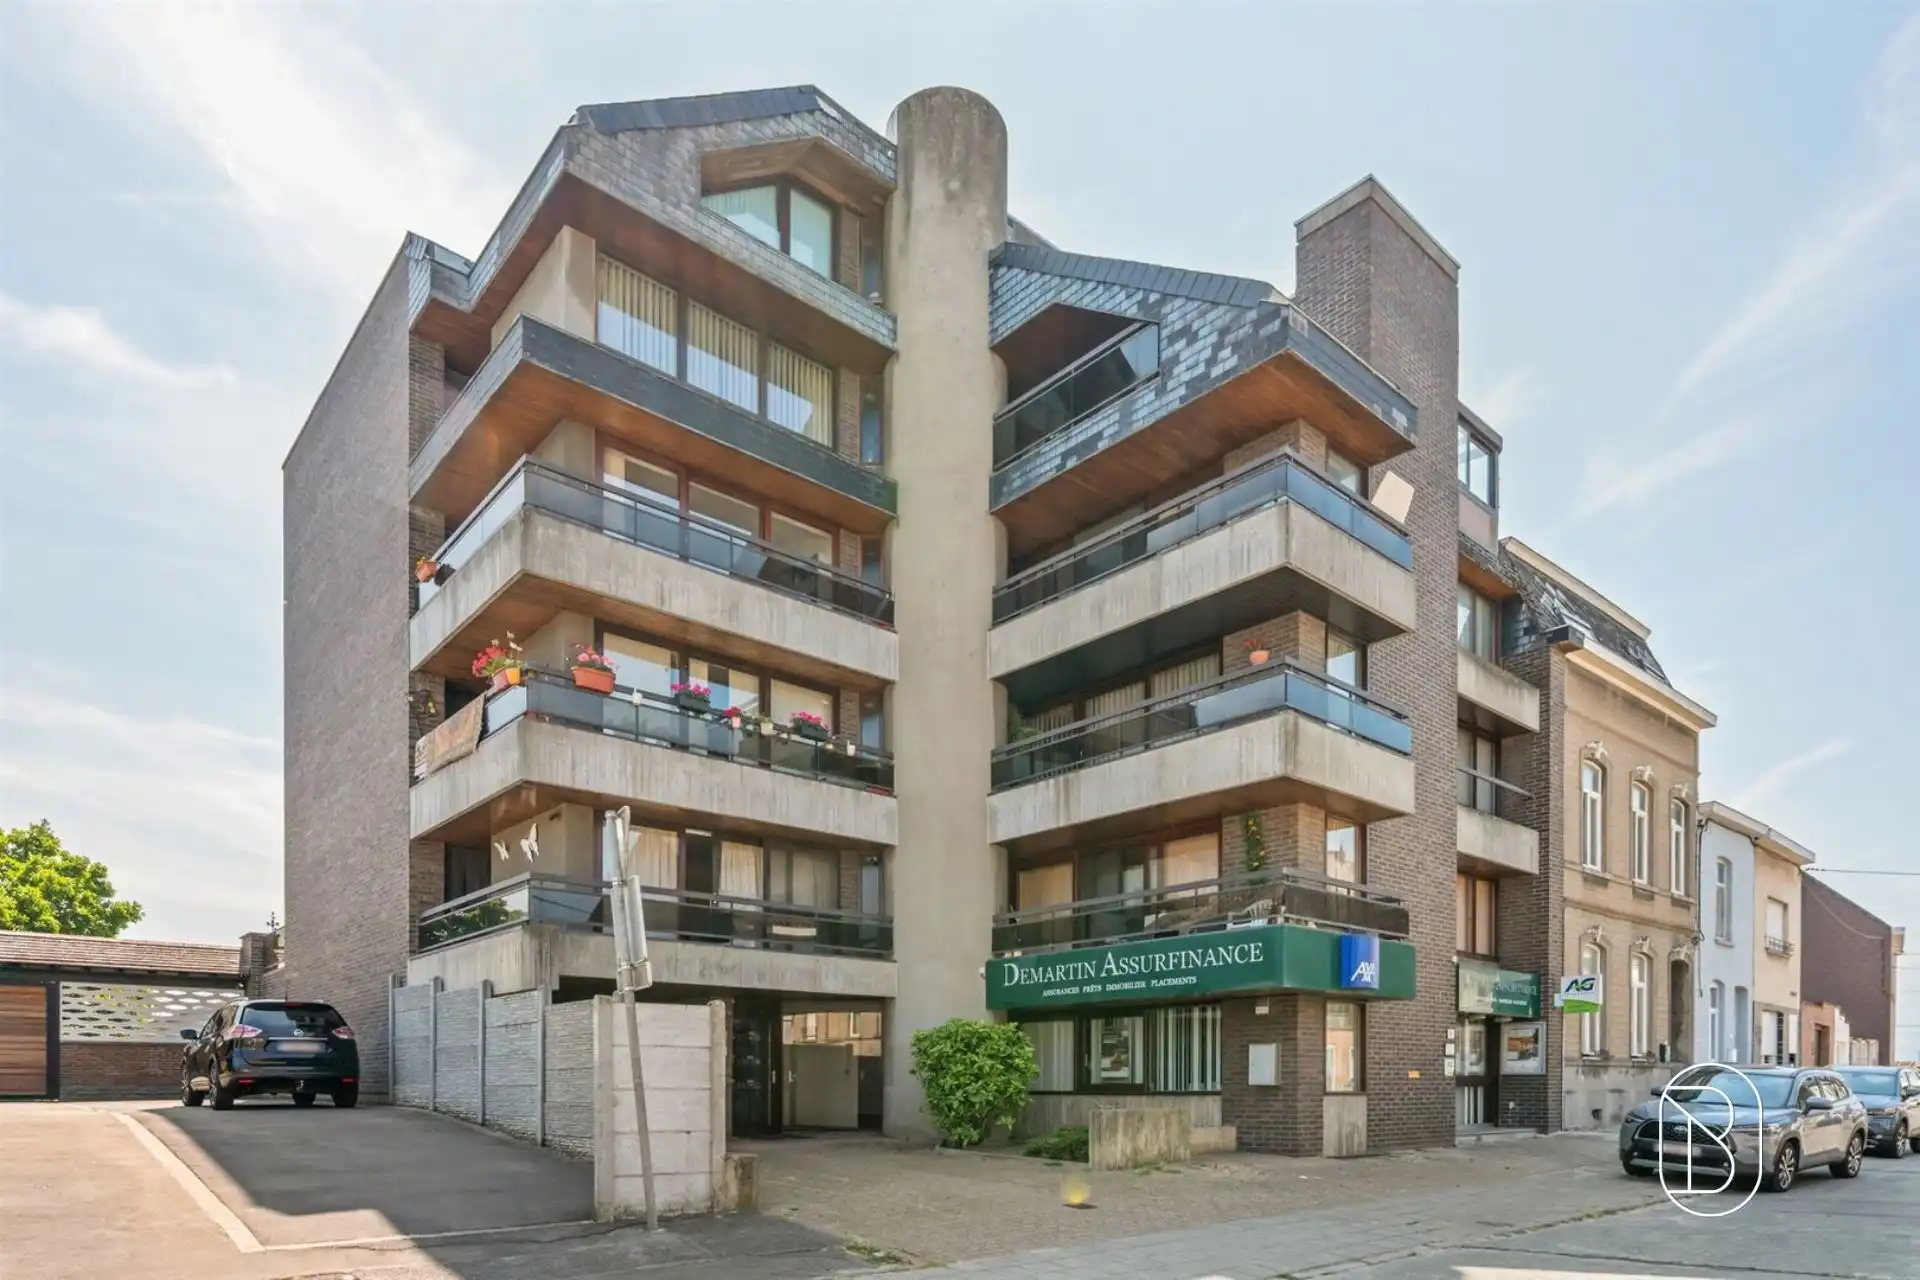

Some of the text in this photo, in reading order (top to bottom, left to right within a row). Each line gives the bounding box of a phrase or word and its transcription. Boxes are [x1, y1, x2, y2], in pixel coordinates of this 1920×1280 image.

[1003, 942, 1264, 987] DEMARTIN ASSURFINANCE
[1350, 961, 1376, 983] AXA
[1042, 986, 1080, 997] ASSURANCES
[1105, 980, 1146, 992] IMMOBILIER
[1150, 976, 1198, 987] PLACEMENTS
[1565, 977, 1596, 992] AG
